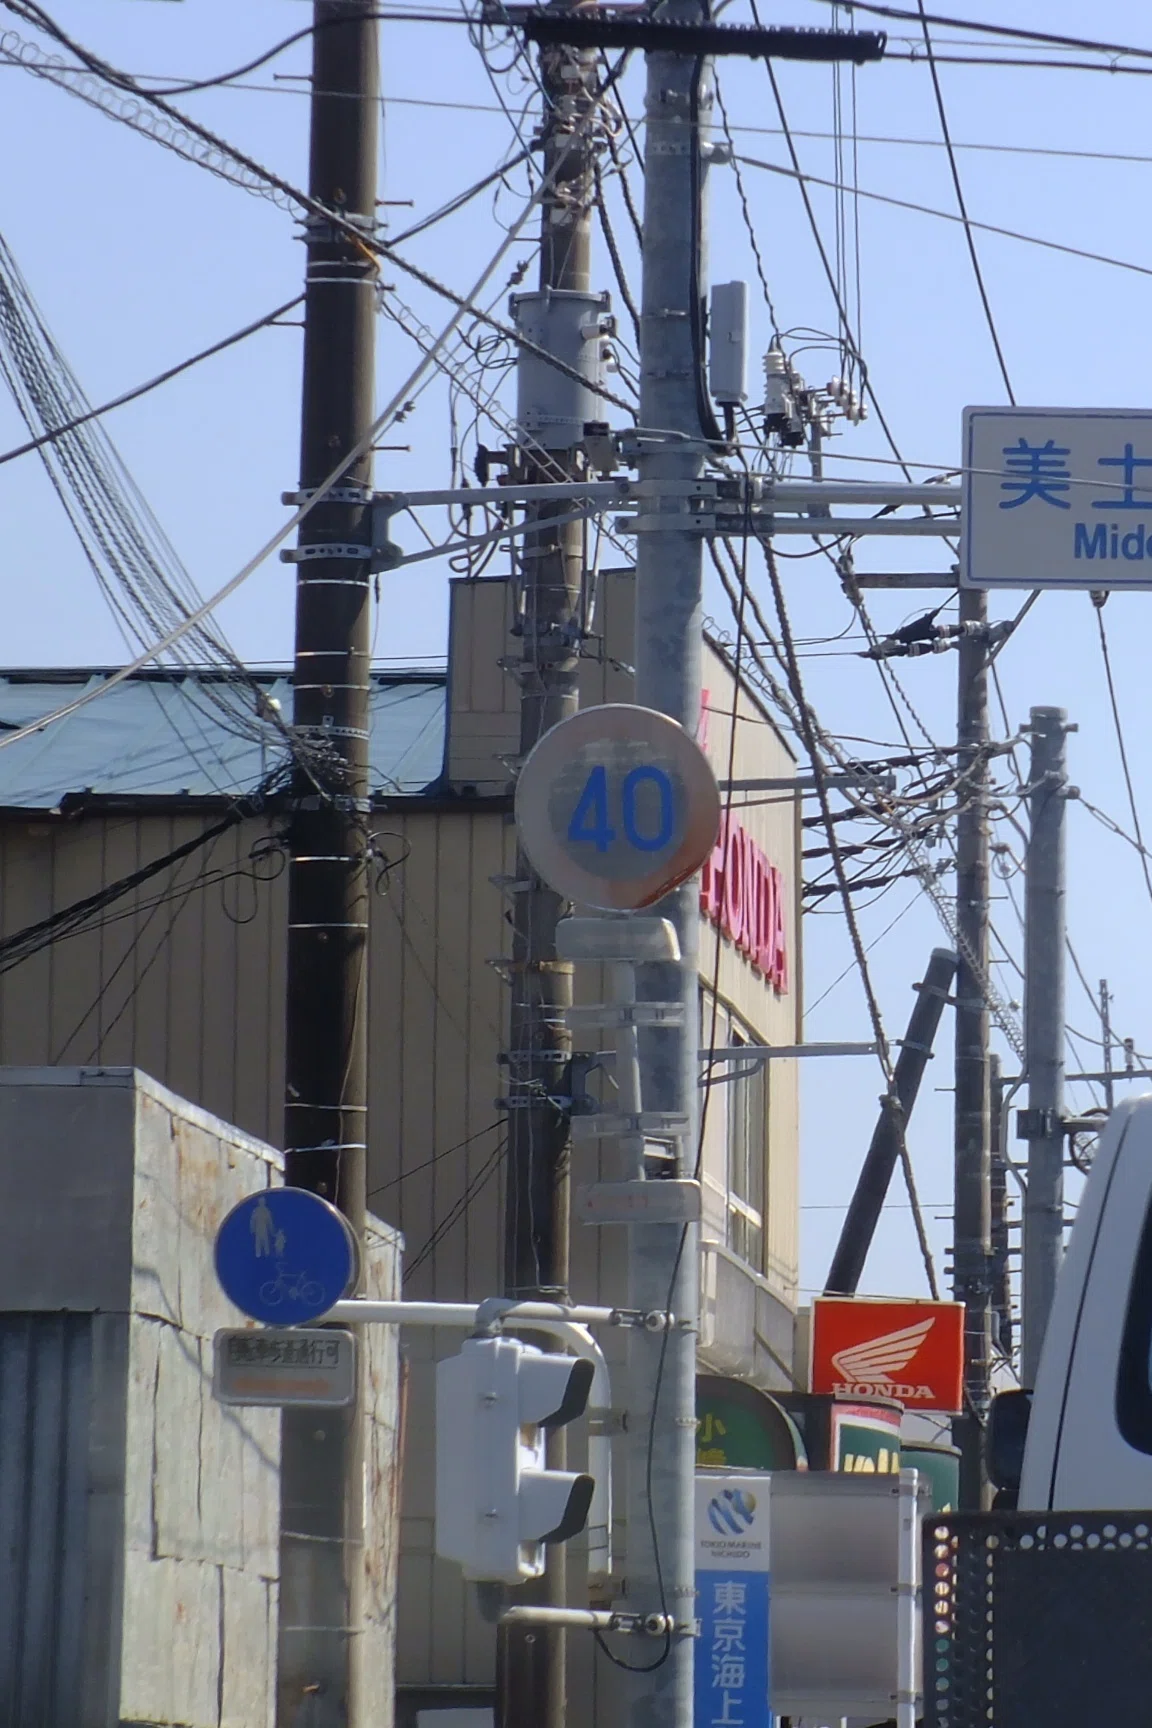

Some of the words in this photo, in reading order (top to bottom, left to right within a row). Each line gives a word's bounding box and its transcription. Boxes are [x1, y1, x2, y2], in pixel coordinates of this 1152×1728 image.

[567, 765, 675, 853] 40
[831, 1382, 936, 1399] HONDA
[711, 1580, 748, 1725] 東京海上
